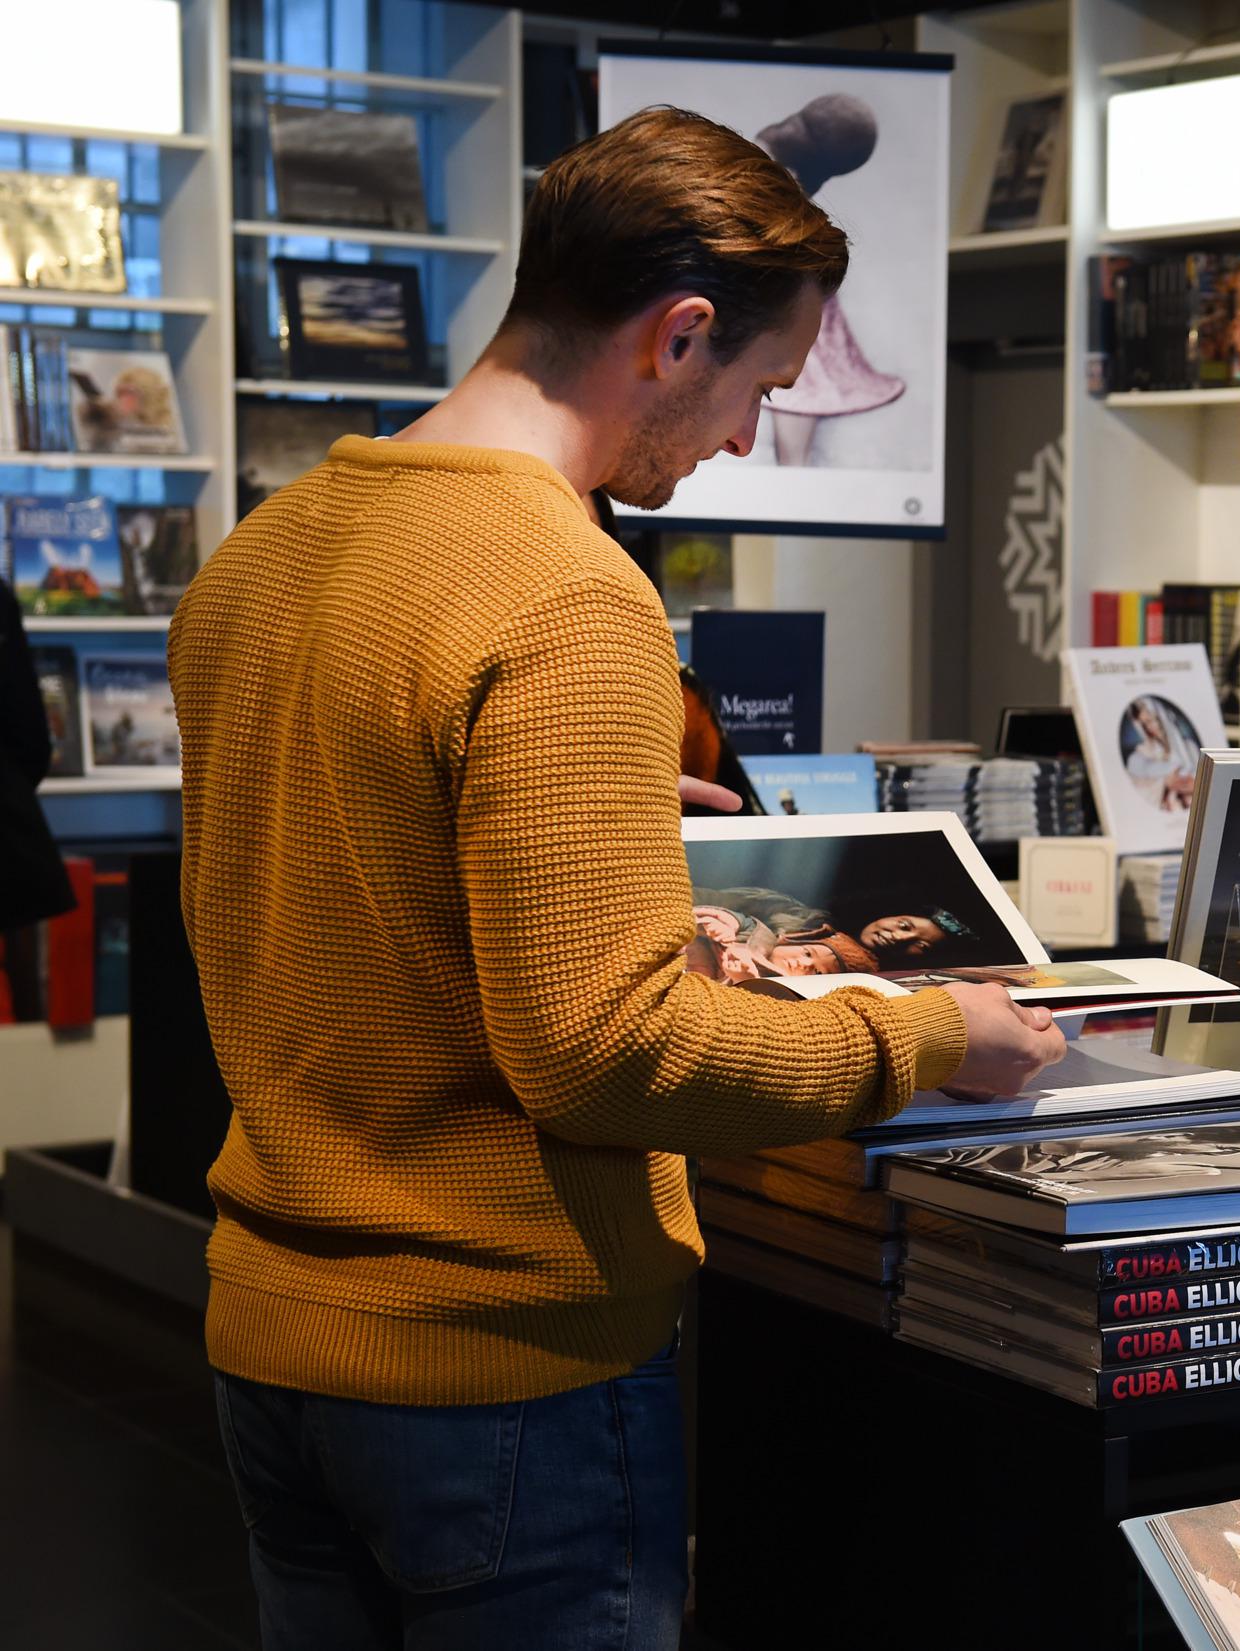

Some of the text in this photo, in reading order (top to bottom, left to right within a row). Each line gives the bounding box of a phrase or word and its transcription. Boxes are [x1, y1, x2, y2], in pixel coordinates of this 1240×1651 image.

[1115, 1252, 1182, 1281] CUBA
[1114, 1288, 1181, 1318] CUBA
[1117, 1329, 1184, 1359] CUBA
[1112, 1368, 1178, 1399] CUBA
